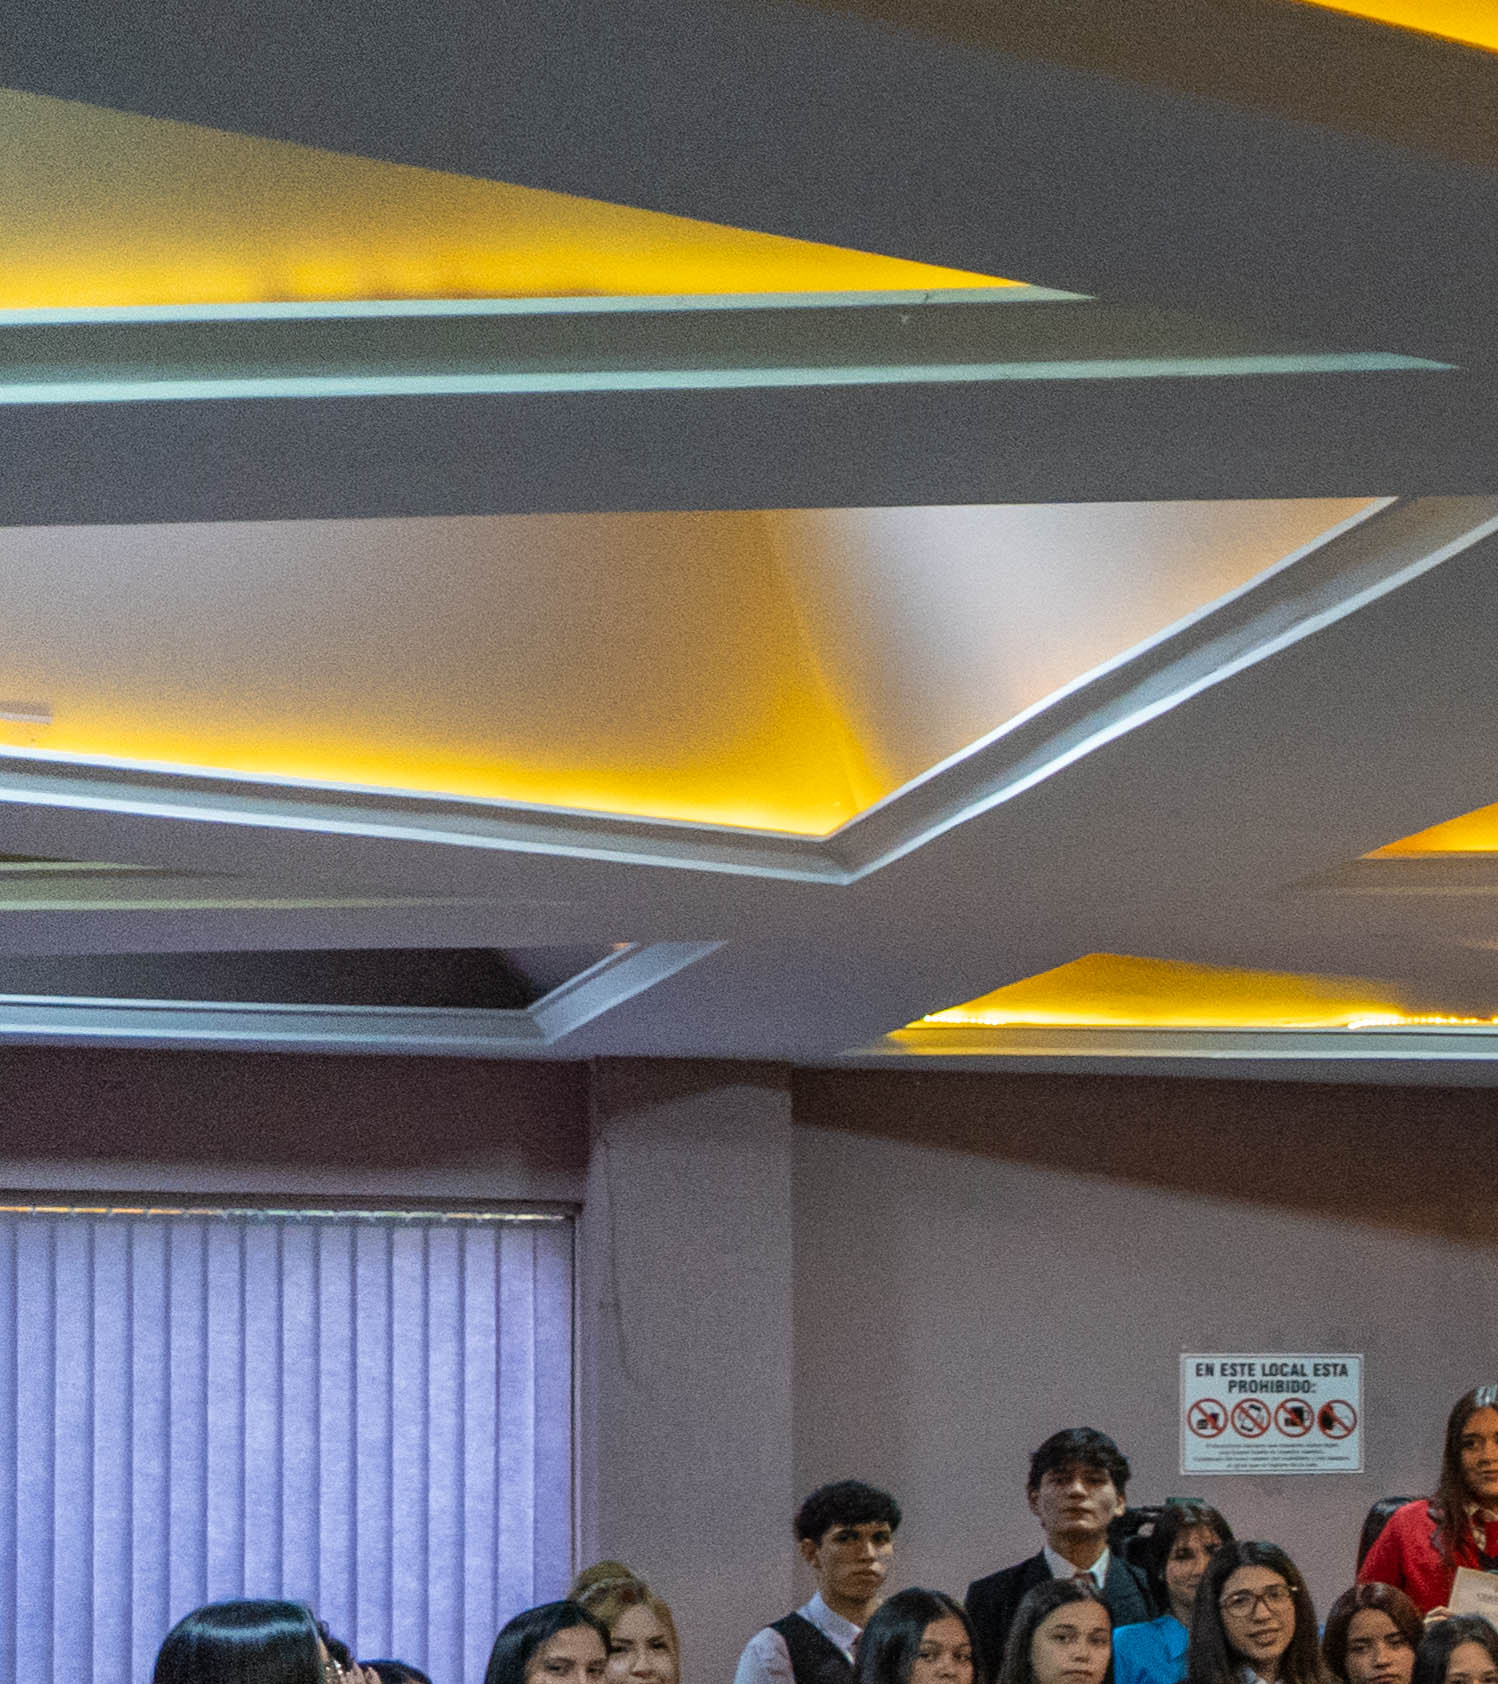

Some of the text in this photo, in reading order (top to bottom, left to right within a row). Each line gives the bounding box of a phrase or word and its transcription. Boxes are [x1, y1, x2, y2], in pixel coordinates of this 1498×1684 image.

[1195, 1363, 1348, 1377] EN ESTE LOCAL ESTA
